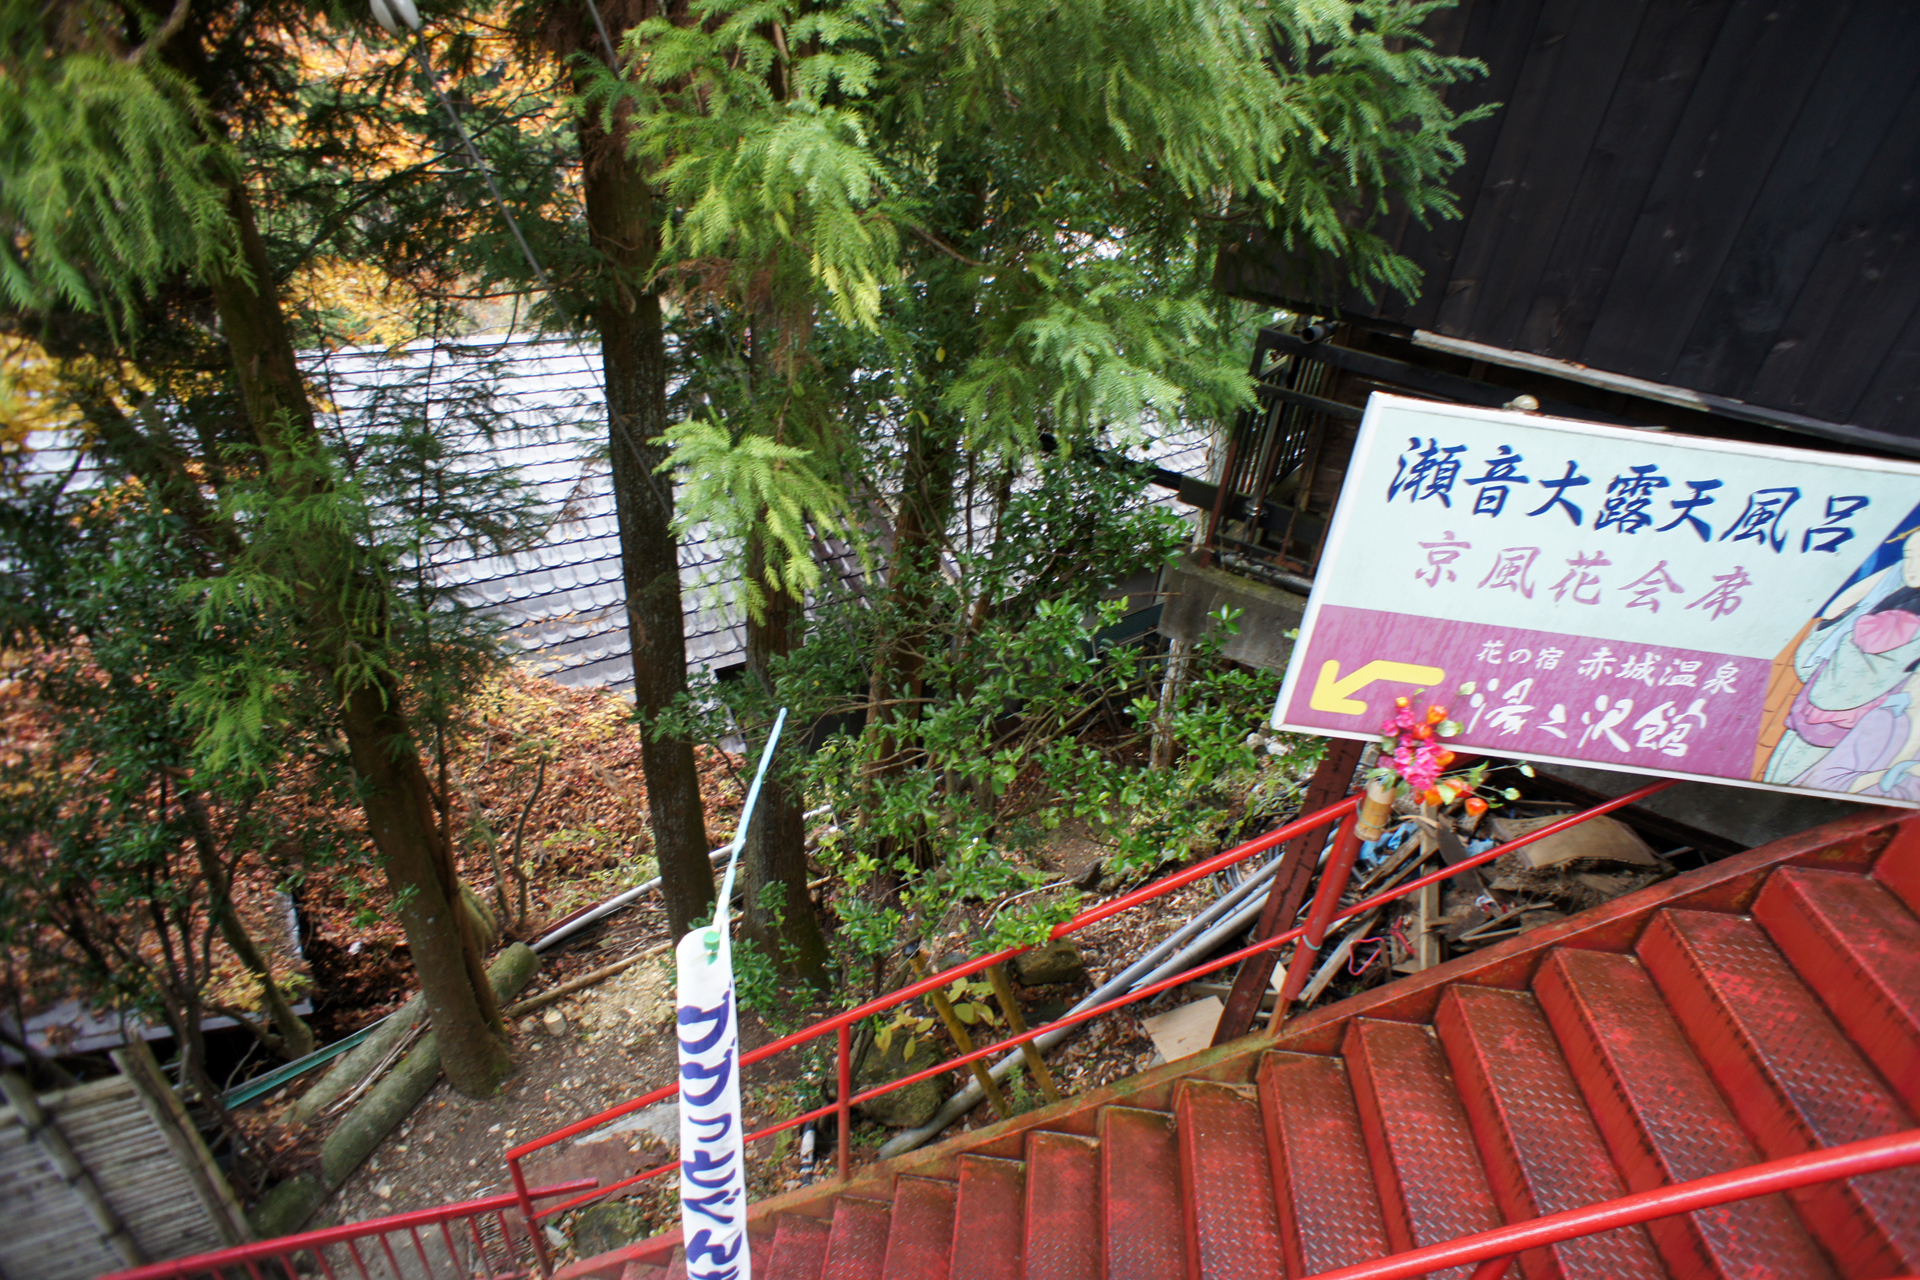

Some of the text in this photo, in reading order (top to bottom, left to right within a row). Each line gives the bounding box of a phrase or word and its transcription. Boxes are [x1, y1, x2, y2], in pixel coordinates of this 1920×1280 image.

[1387, 436, 1870, 554] 瀬音大露天風呂
[1414, 530, 1754, 621] 京風花会席
[1476, 639, 1740, 695] 花の宿 赤城温泉
